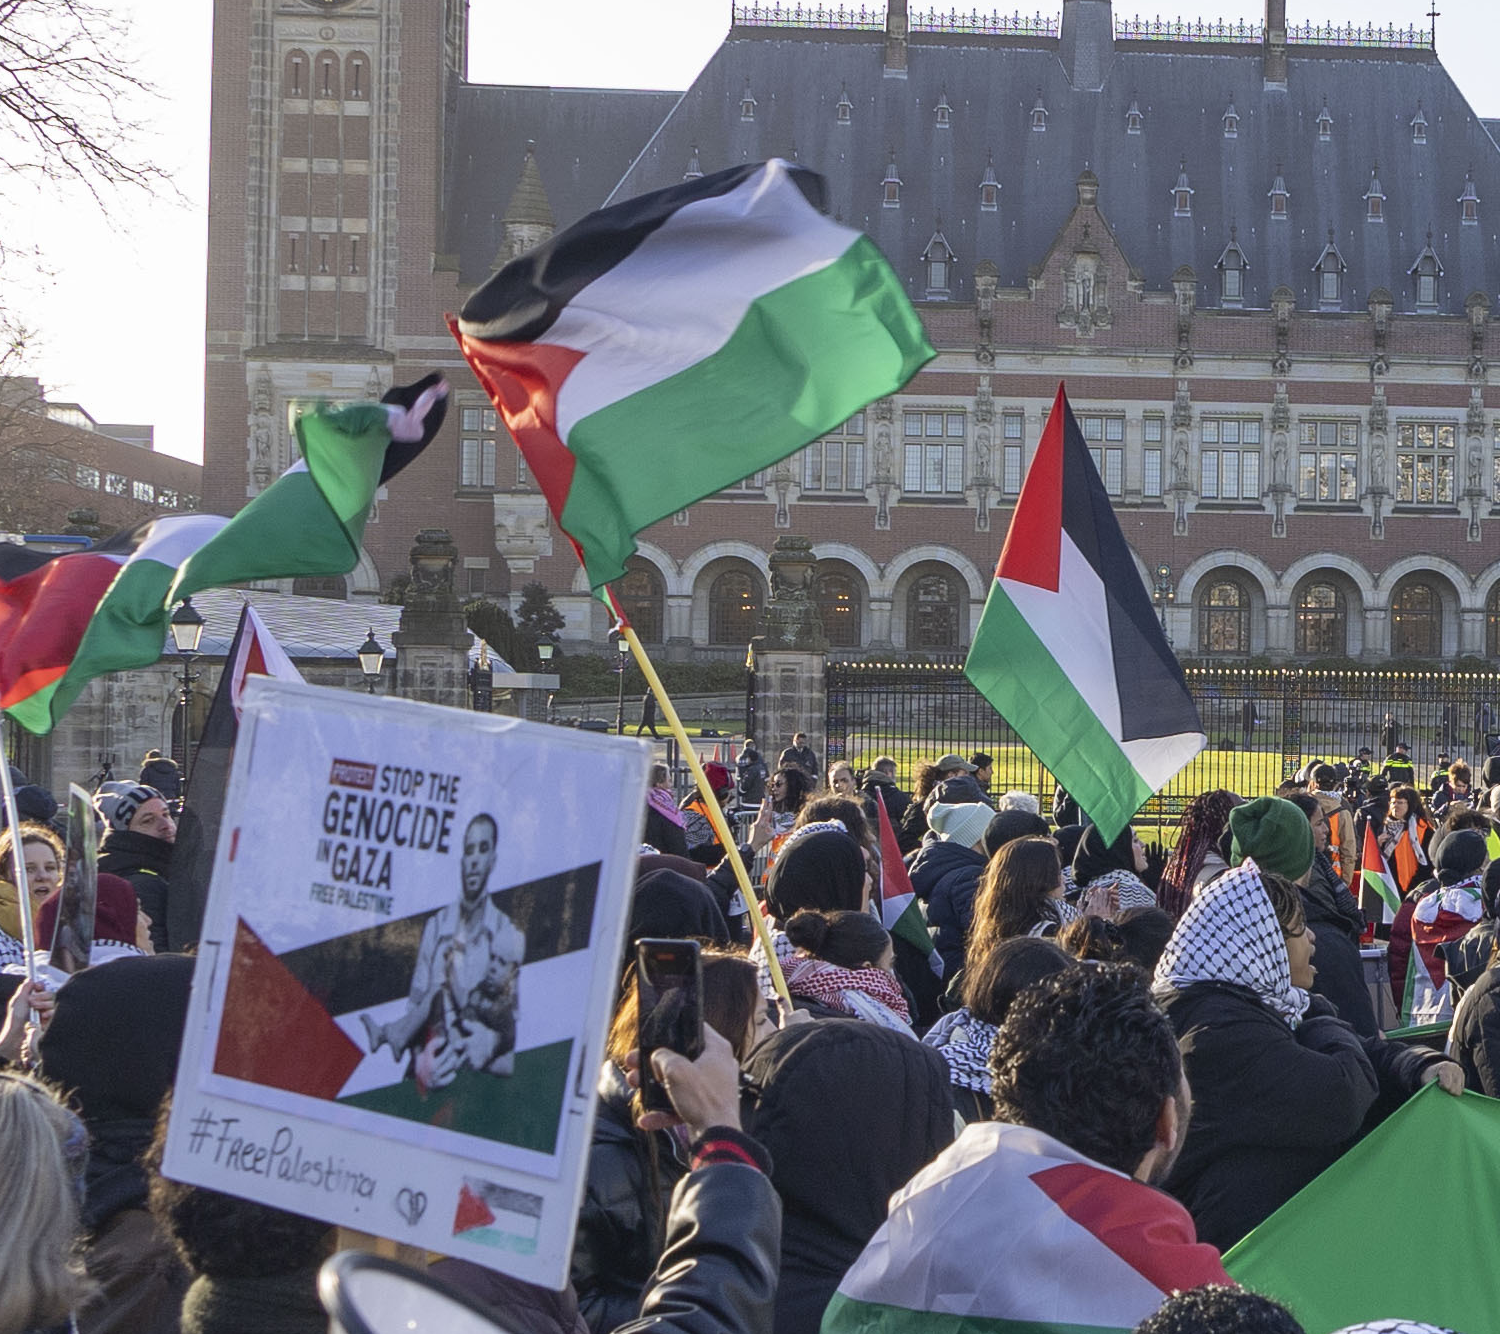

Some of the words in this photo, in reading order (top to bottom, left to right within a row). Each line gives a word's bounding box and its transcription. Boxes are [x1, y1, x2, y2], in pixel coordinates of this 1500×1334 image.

[380, 764, 425, 798] STOP
[428, 771, 461, 805] THE
[322, 789, 456, 855] GENOCIDE
[316, 838, 332, 863] IN
[331, 841, 393, 891] GAZA
[309, 881, 336, 905] FREE
[336, 886, 394, 916] PALESTINE
